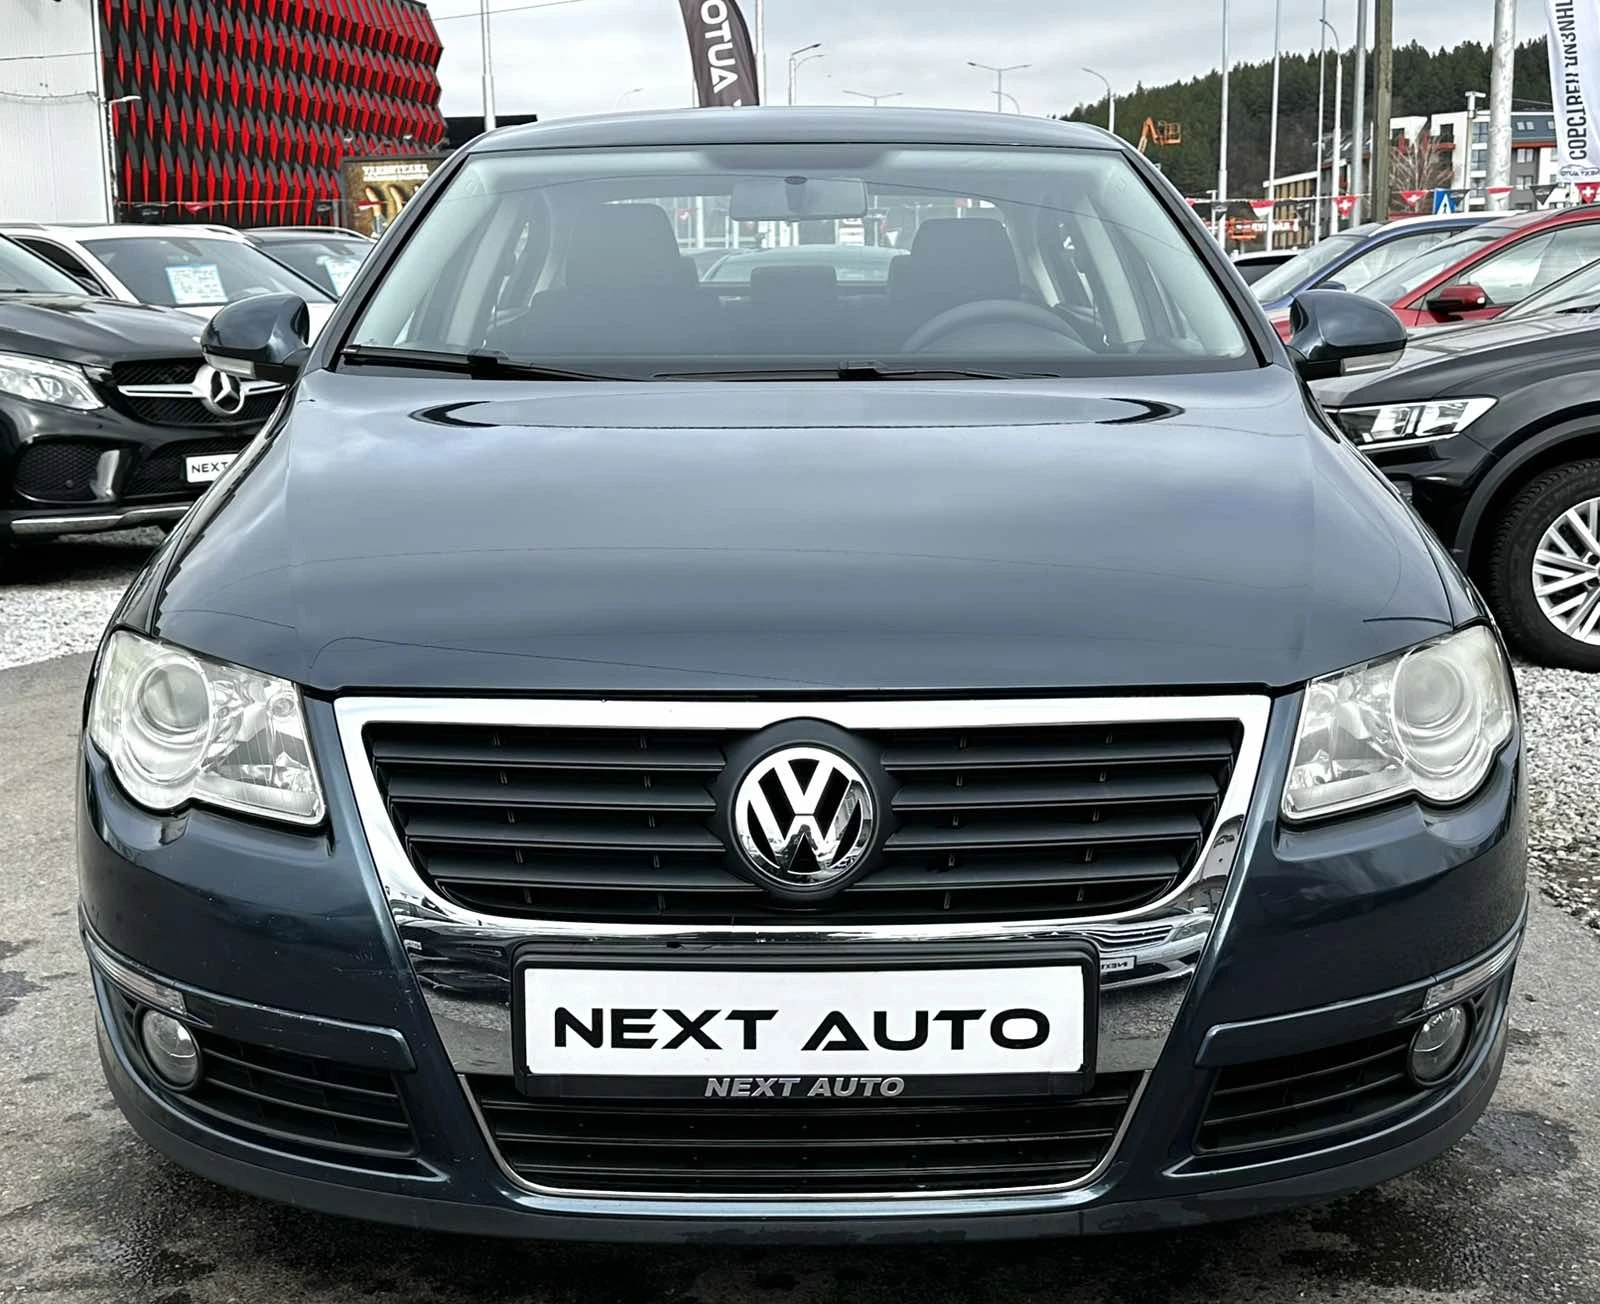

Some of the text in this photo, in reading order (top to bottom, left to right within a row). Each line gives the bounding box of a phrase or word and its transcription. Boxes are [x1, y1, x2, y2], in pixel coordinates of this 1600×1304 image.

[191, 462, 228, 473] NEXT
[554, 1007, 1050, 1051] NEXT AUTO
[704, 1077, 905, 1097] NEXT AUTO
